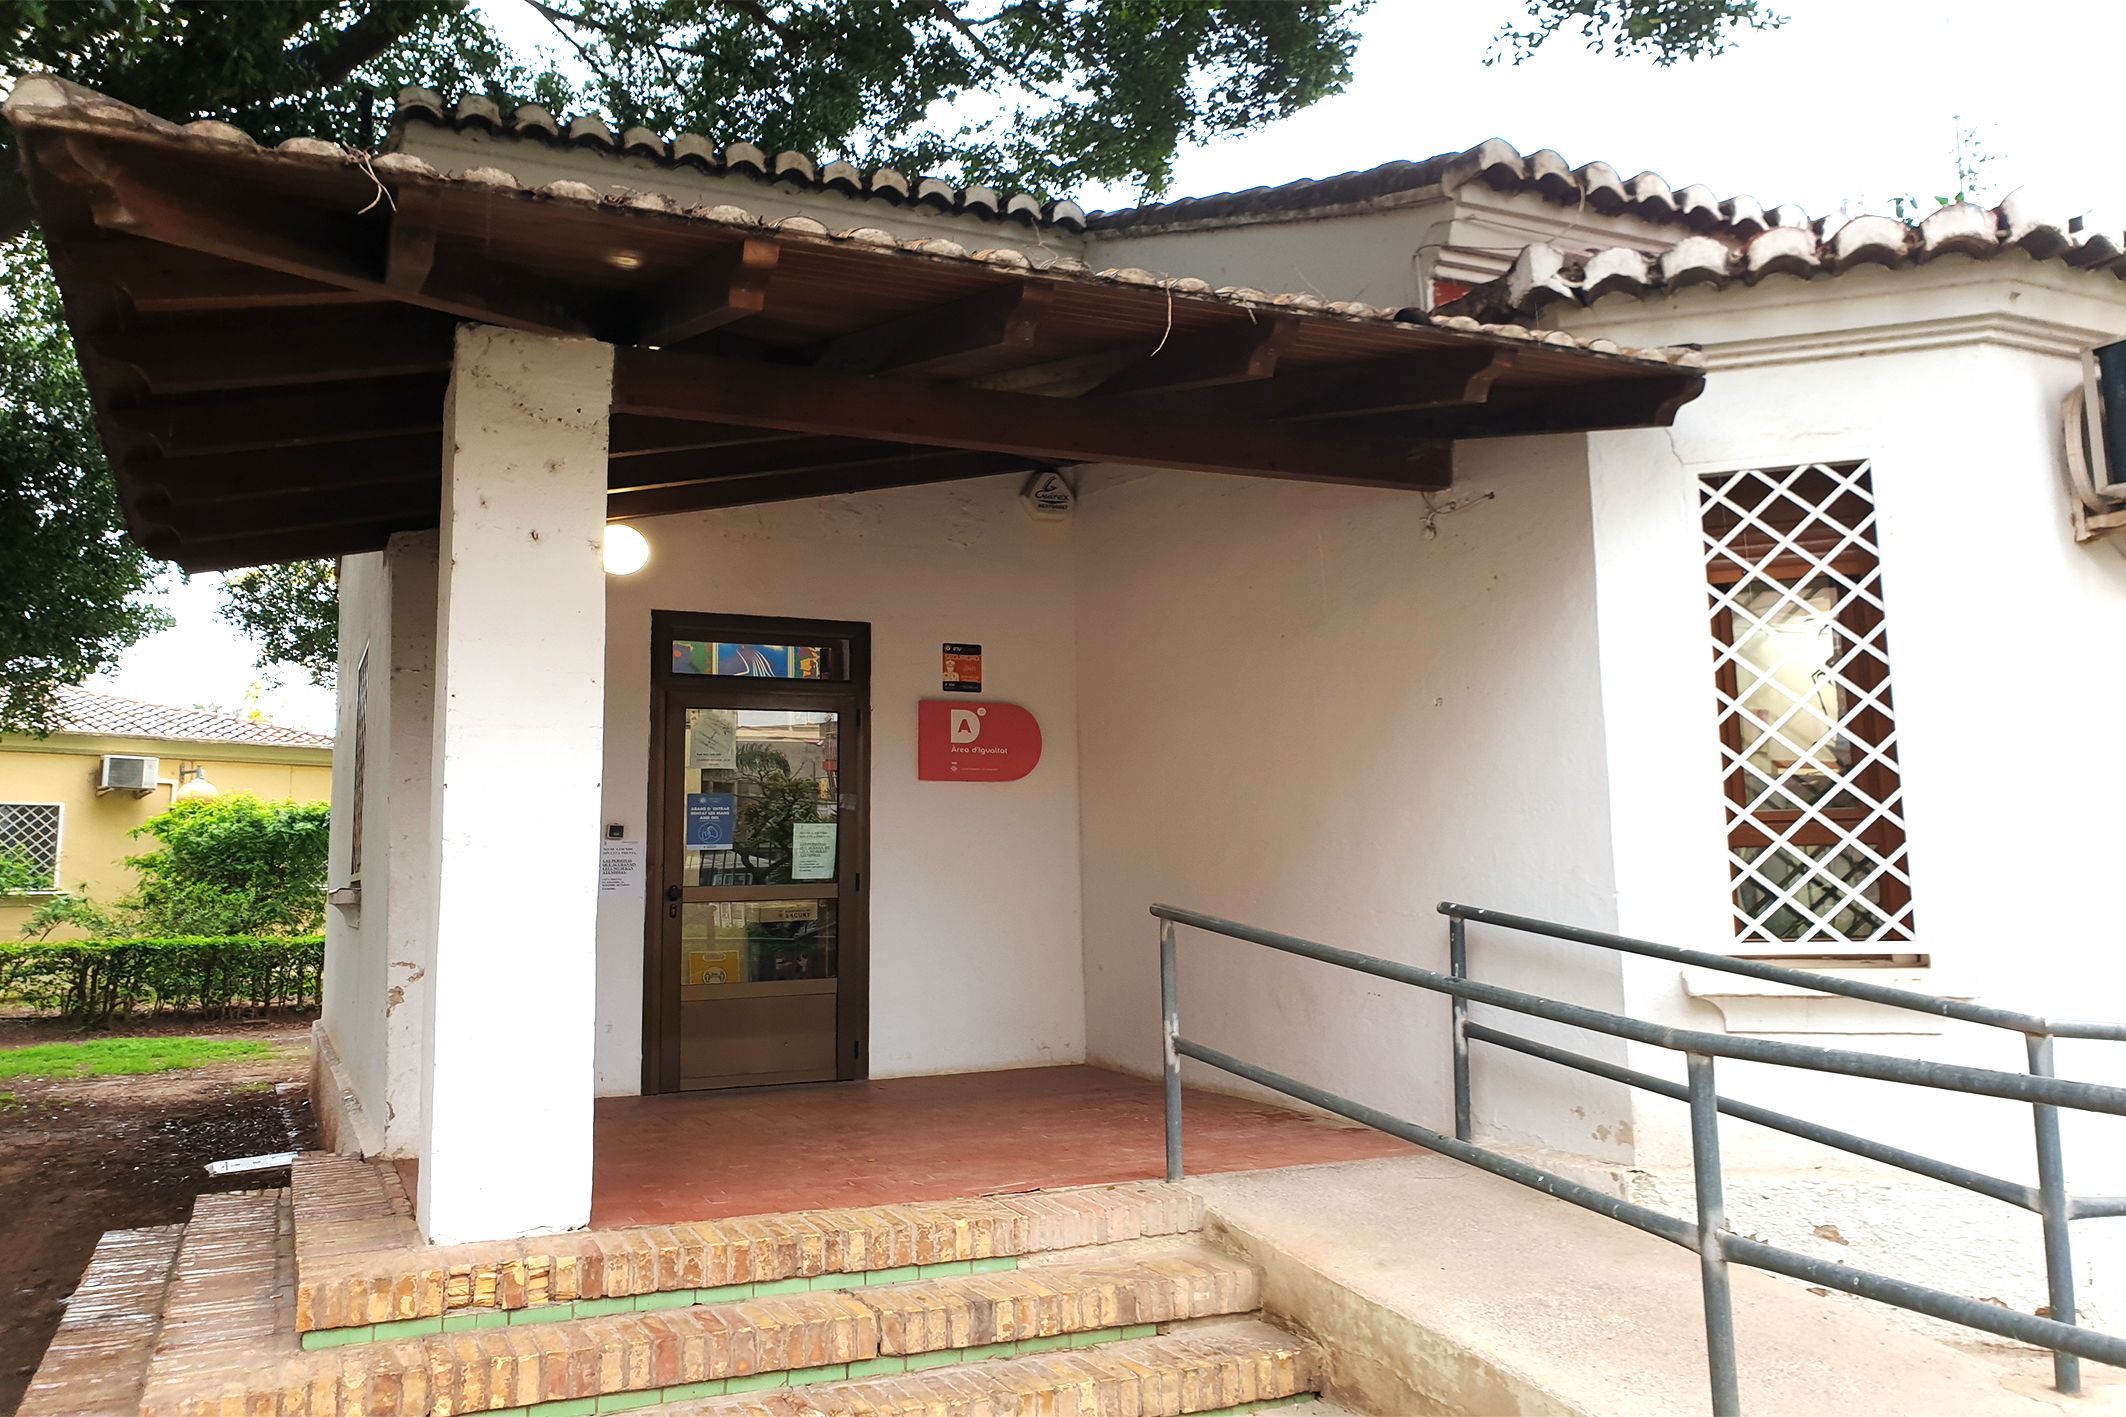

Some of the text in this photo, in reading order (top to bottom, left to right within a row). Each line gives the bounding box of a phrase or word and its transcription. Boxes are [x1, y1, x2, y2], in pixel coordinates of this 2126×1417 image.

[958, 719, 971, 733] A
[951, 744, 1008, 756] Àrea d'Igualtat
